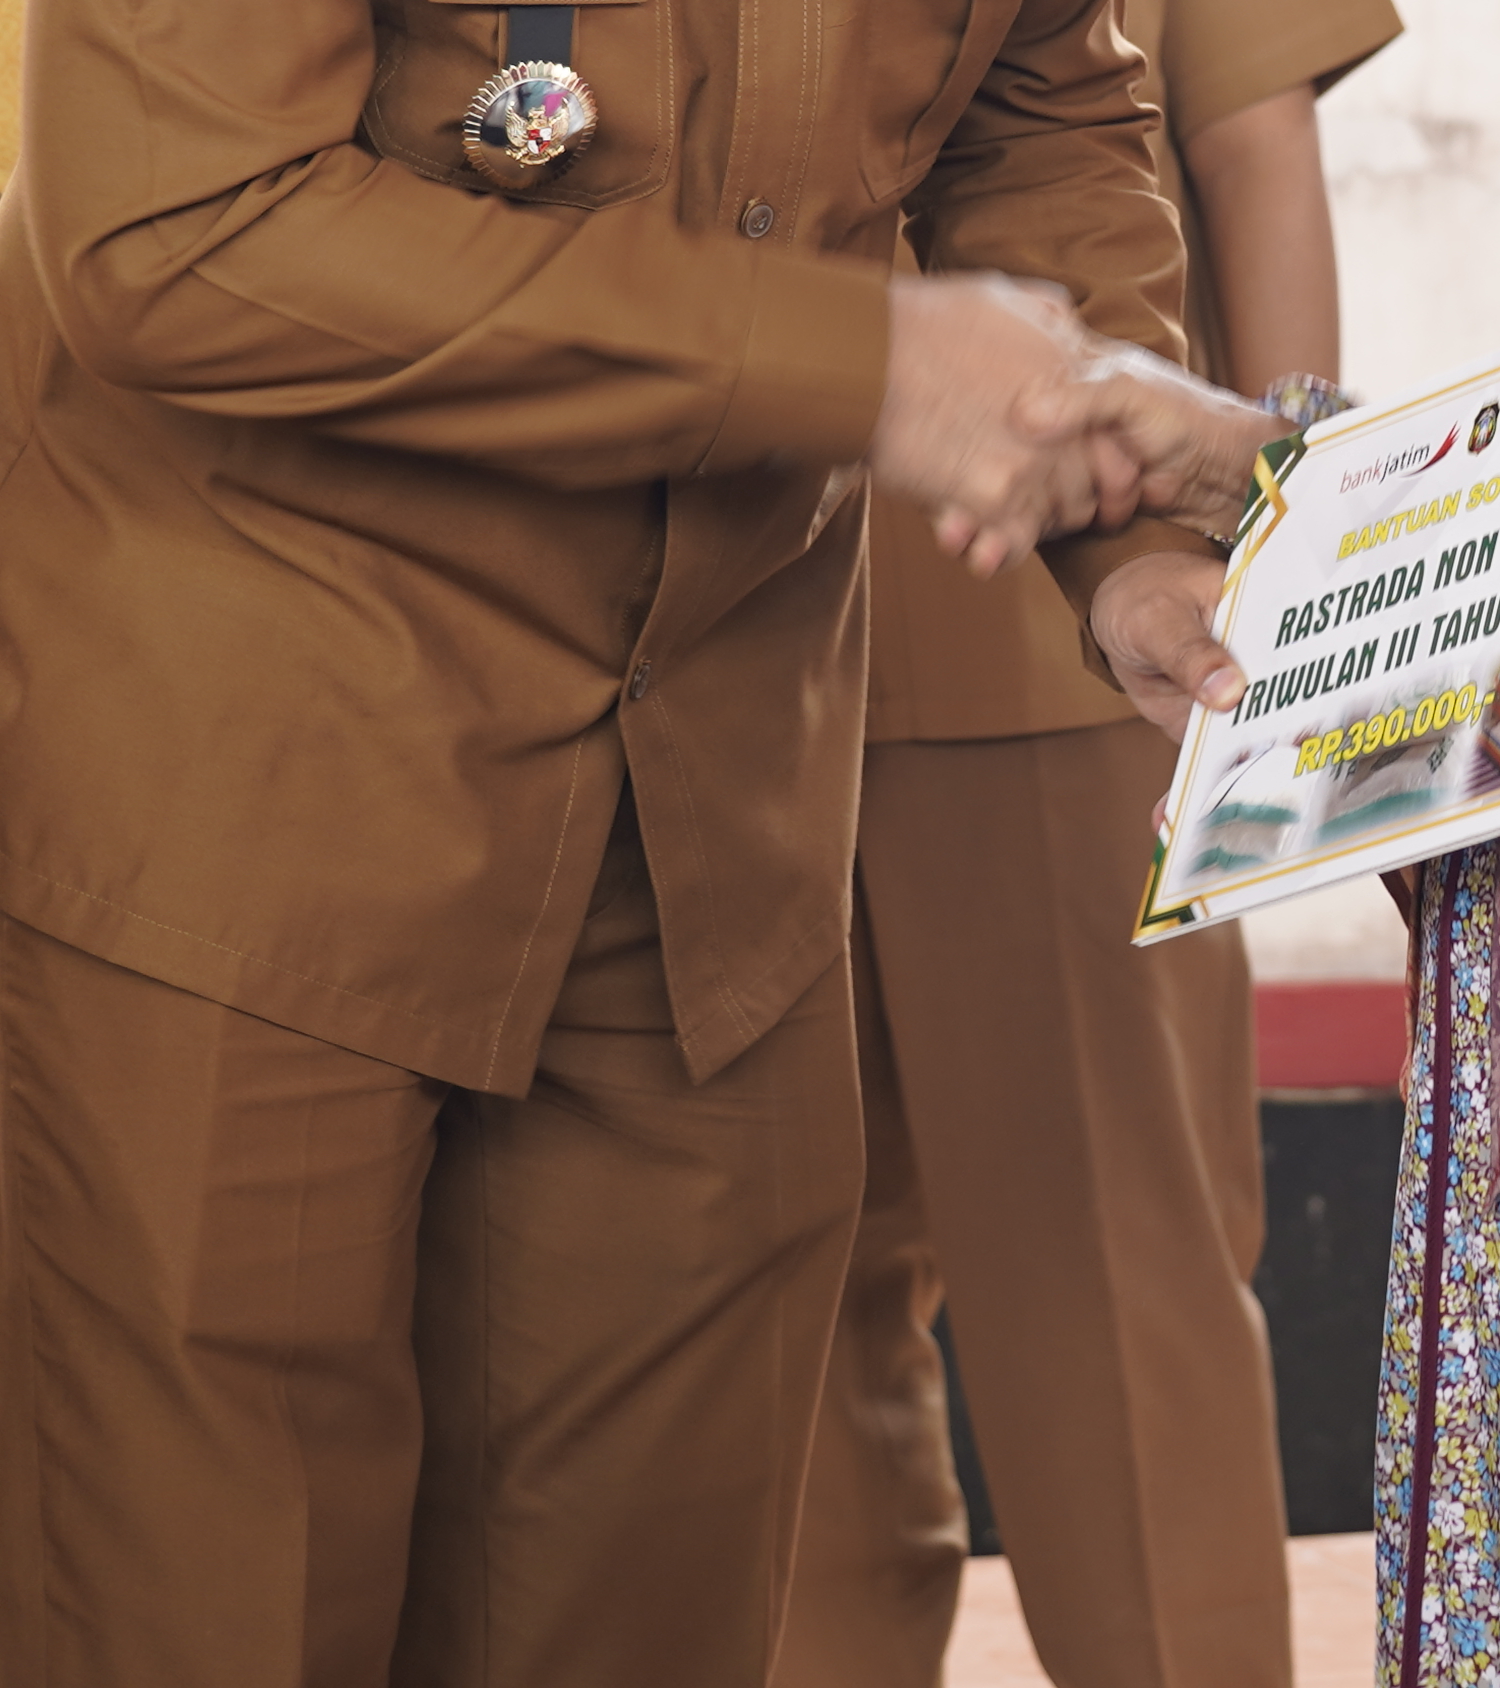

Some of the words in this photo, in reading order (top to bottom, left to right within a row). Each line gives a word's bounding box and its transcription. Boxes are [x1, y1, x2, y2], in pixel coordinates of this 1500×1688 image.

[1339, 443, 1431, 495] bankjatim
[1337, 489, 1463, 561] BANTUAN
[1274, 557, 1426, 650] RASTRADA
[1432, 529, 1500, 592] NON
[1231, 637, 1381, 727] TRIWULAN
[1383, 622, 1422, 673] III
